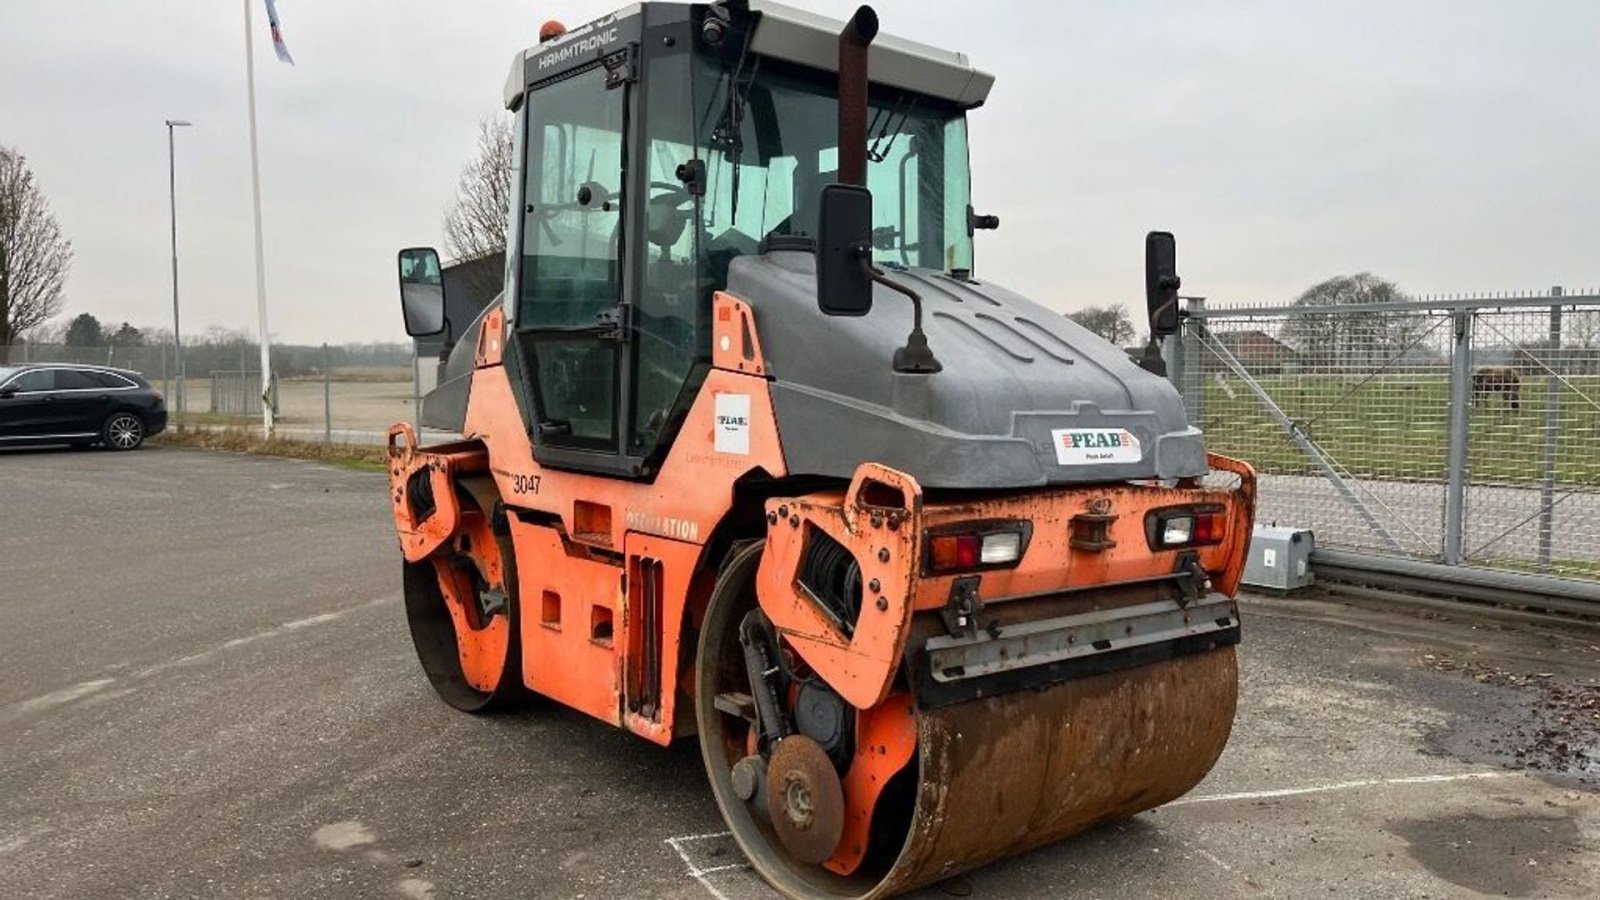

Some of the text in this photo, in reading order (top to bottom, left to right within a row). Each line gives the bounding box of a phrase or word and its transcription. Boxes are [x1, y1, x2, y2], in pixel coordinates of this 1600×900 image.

[539, 28, 618, 70] HAMMTRONIC
[1071, 432, 1121, 448] PEAB
[513, 474, 541, 494] 3047
[626, 511, 698, 540] OSCATION
